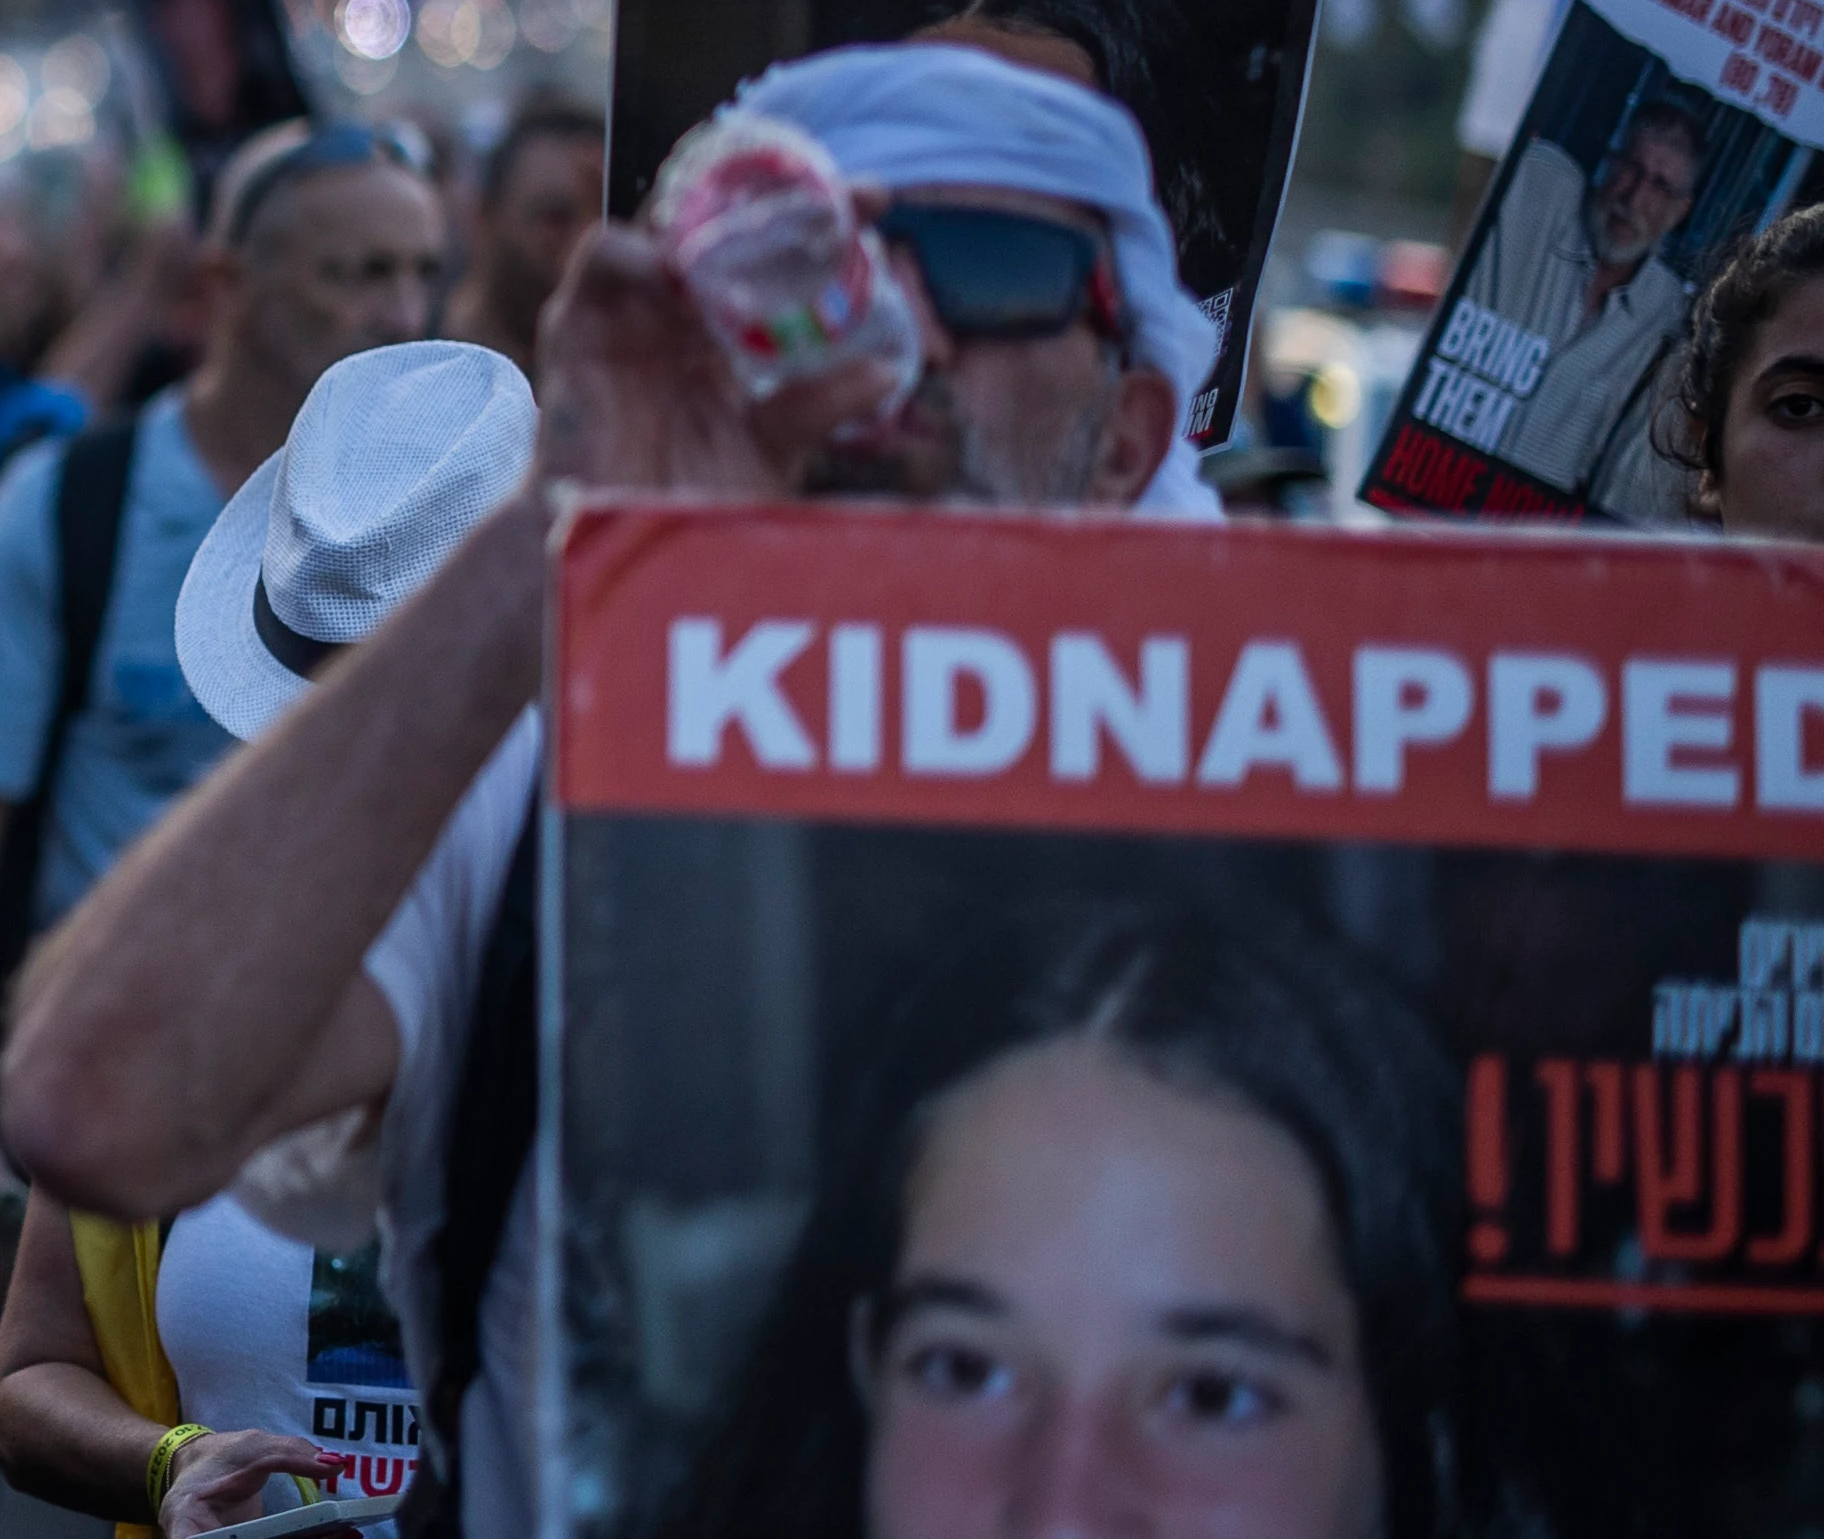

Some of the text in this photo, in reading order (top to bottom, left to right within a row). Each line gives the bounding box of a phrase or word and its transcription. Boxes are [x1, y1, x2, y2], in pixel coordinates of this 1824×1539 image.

[1437, 297, 1551, 397] BRING
[1412, 354, 1517, 455] THEM
[1381, 424, 1489, 519] HOME
[664, 615, 1824, 813] KIDNAPPED
